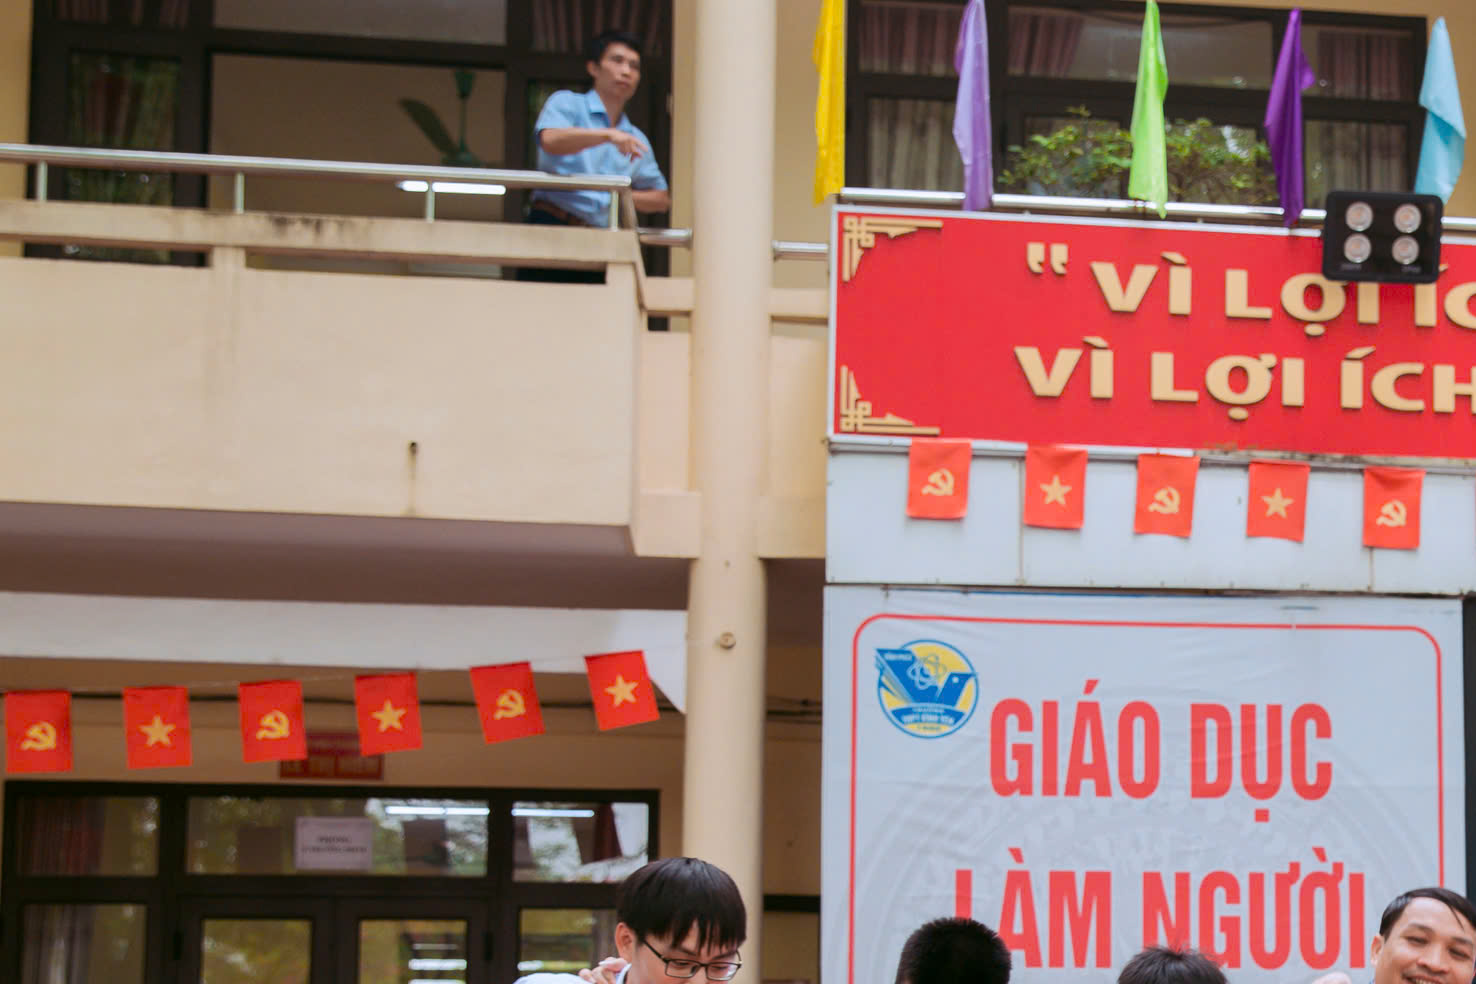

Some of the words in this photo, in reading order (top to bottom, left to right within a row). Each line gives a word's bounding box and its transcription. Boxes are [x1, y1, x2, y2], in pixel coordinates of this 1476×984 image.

[1015, 336, 1113, 397] VÌ
[1151, 352, 1304, 419] LỢI
[990, 679, 1160, 799] GIÁO
[1190, 703, 1332, 822] DỤC
[1143, 847, 1365, 970] NGƯỜI
